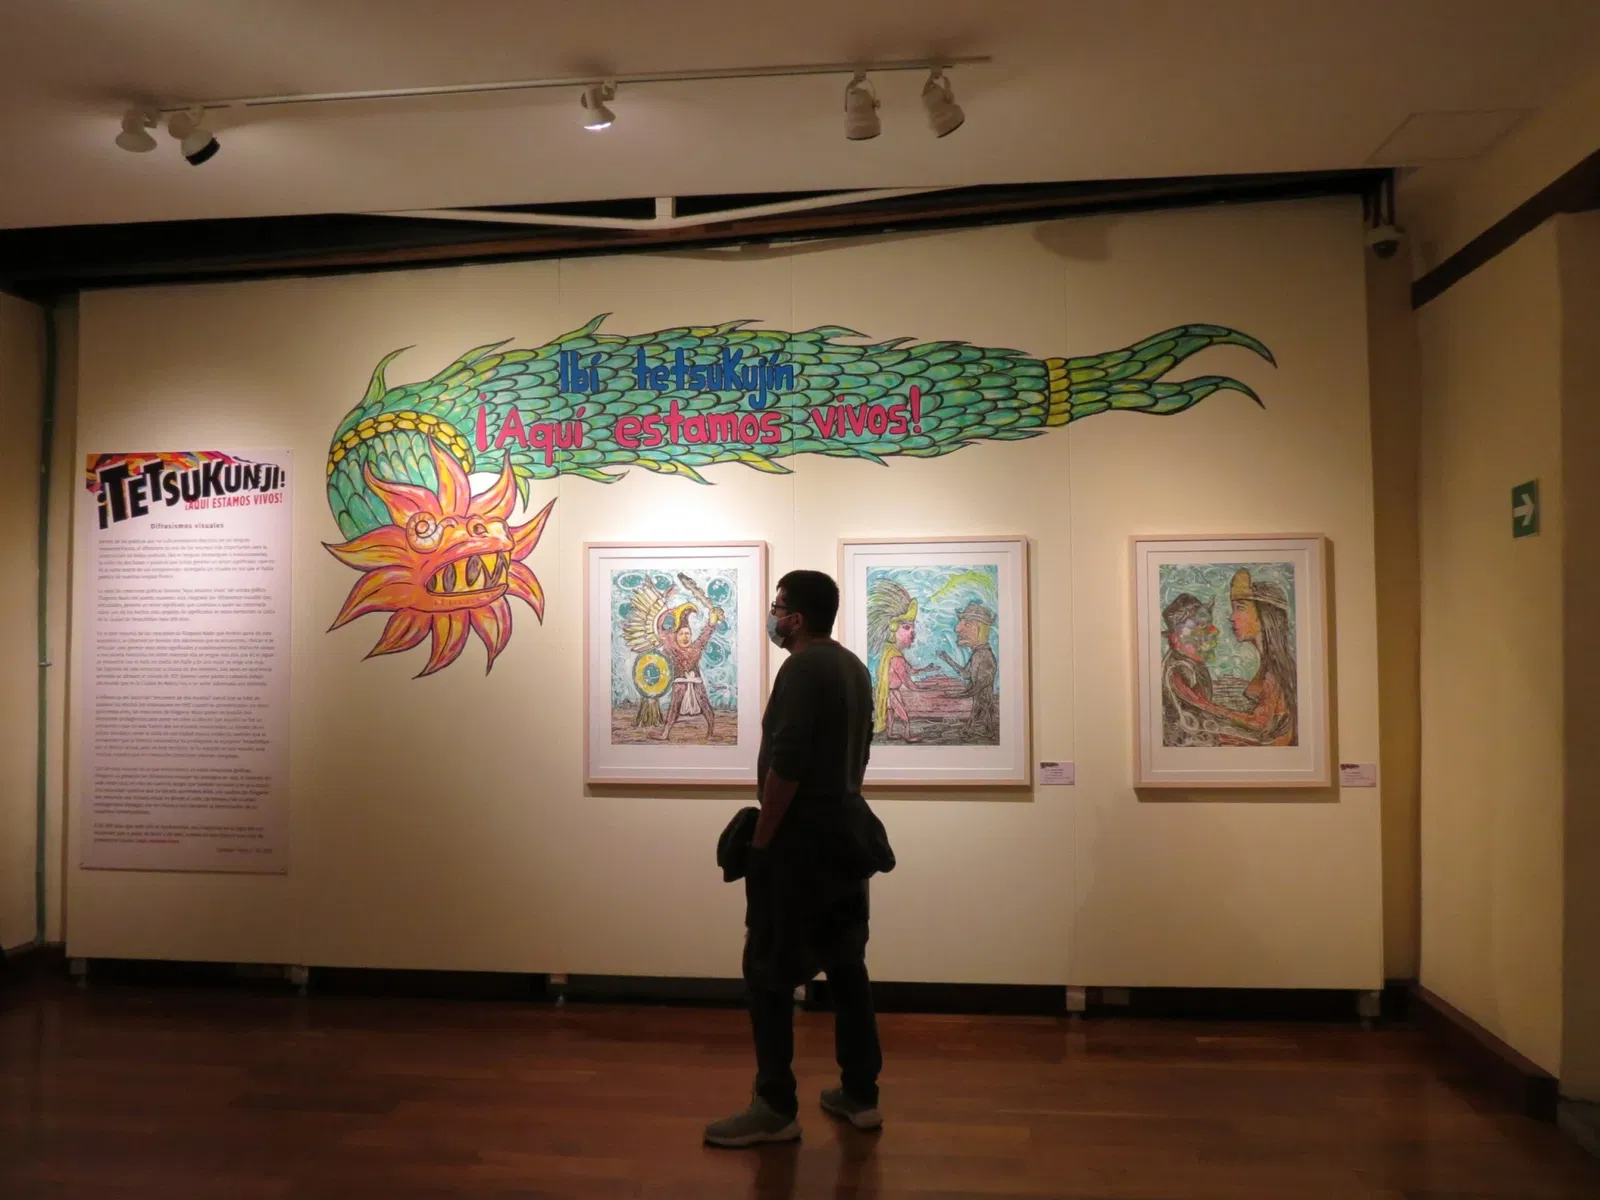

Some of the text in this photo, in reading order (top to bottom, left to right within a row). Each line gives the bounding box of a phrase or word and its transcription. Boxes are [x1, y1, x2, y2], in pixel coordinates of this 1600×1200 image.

[560, 350, 602, 392] Ibí
[615, 400, 782, 448] estamos
[811, 385, 921, 438] vivos!
[212, 495, 251, 508] ESTAMOS
[253, 492, 283, 505] VIVOS!
